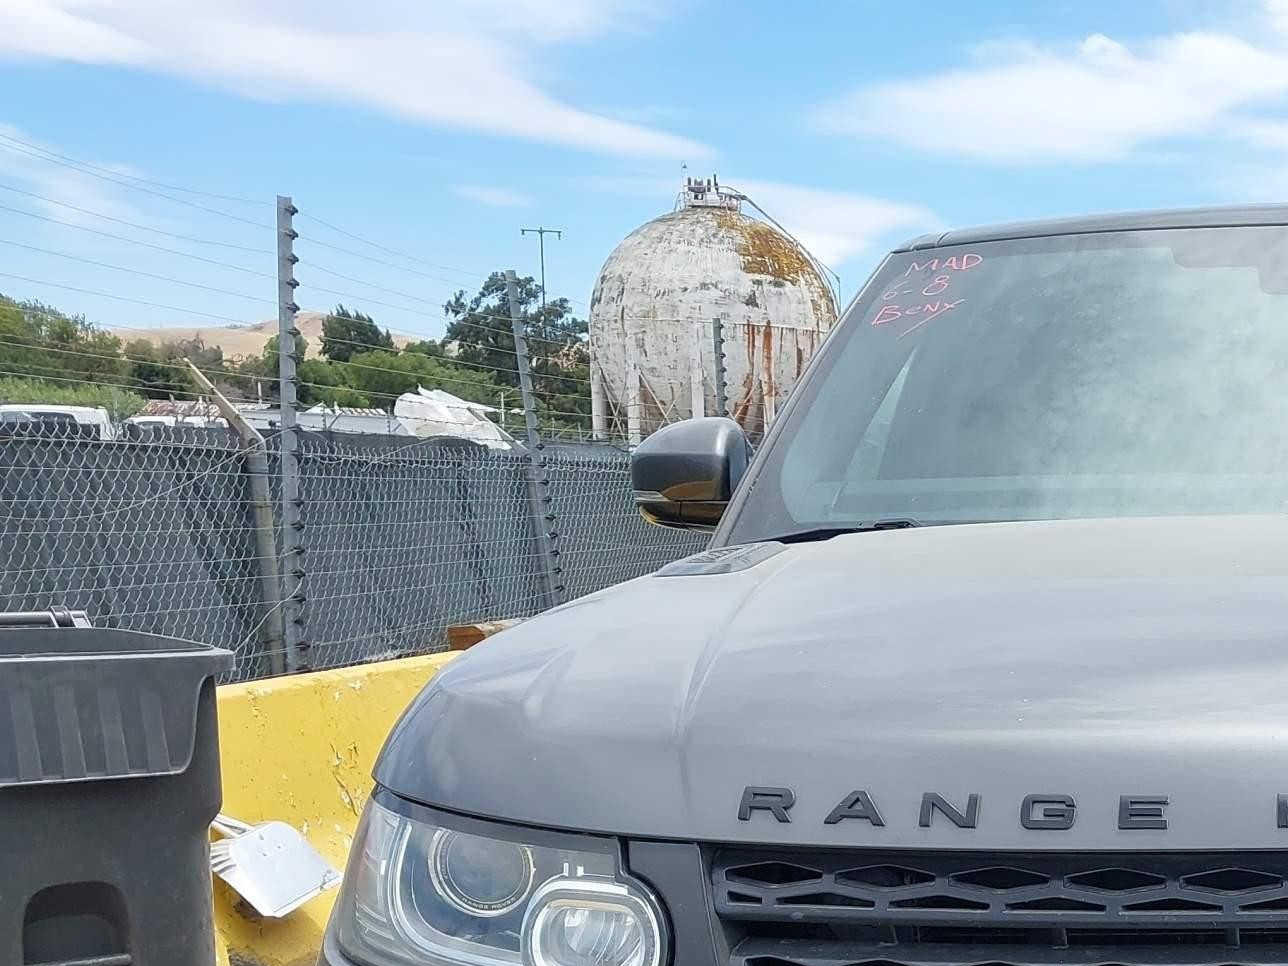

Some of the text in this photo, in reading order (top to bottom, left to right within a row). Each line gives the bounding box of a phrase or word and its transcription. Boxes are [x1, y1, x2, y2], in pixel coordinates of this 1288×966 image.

[905, 254, 983, 277] MAD
[737, 785, 1170, 830] RANGE
[461, 897, 489, 910] RANGE
